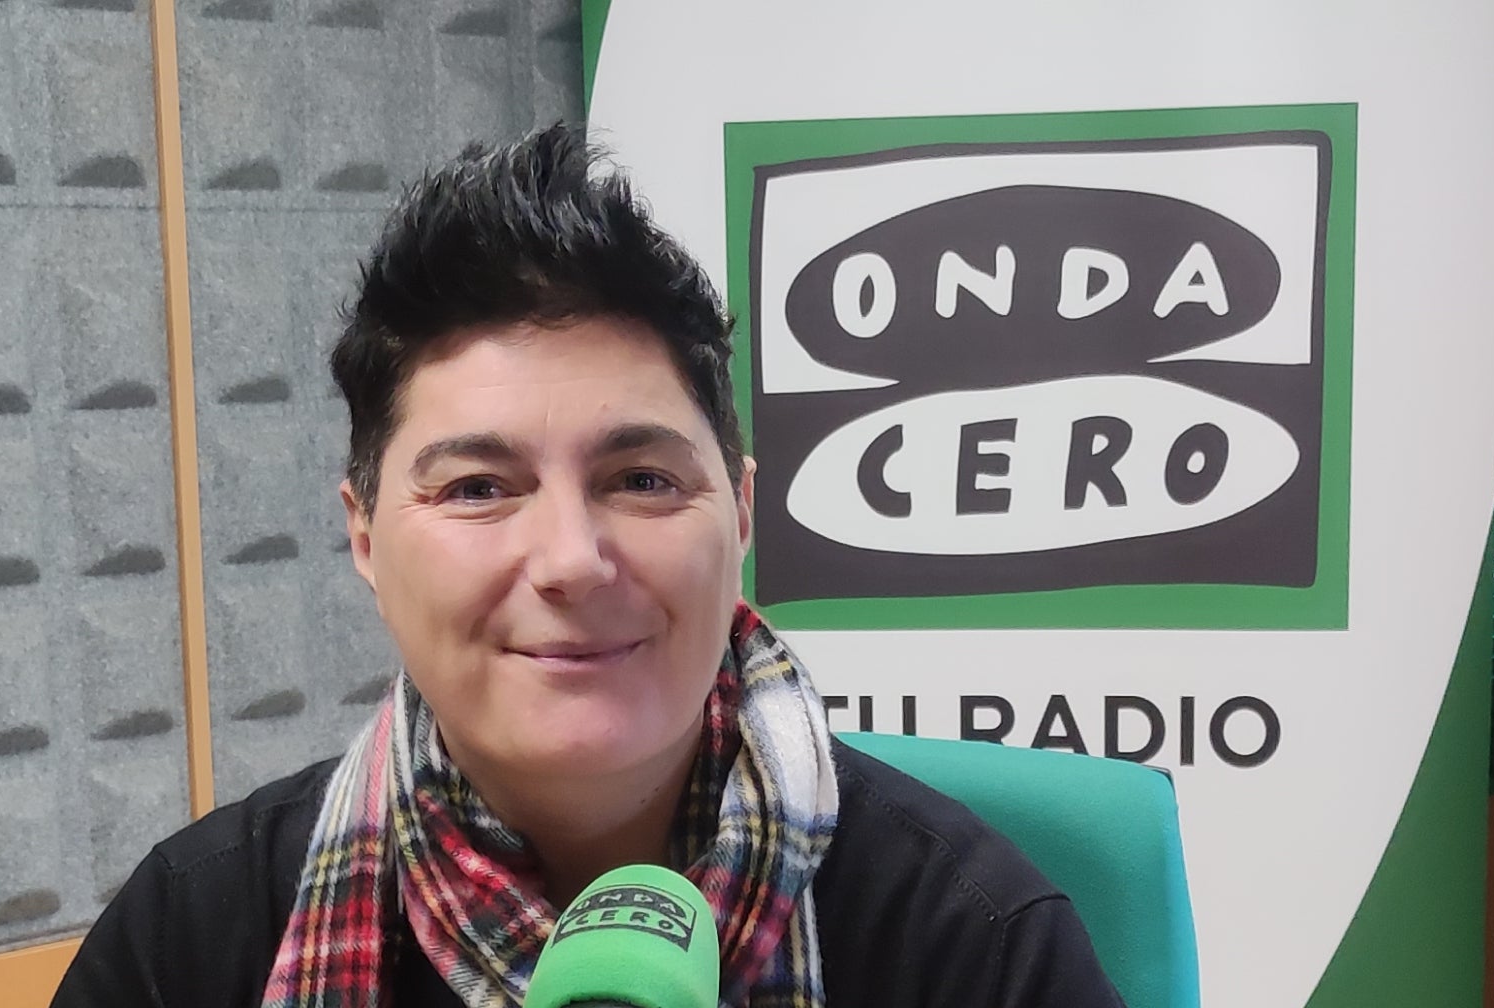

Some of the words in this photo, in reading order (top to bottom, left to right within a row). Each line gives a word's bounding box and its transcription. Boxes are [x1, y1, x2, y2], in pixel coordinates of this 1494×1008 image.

[832, 241, 1230, 339] ONDA
[856, 414, 1230, 519] CERO
[959, 694, 1282, 768] RADIO
[575, 909, 674, 930] CERO
